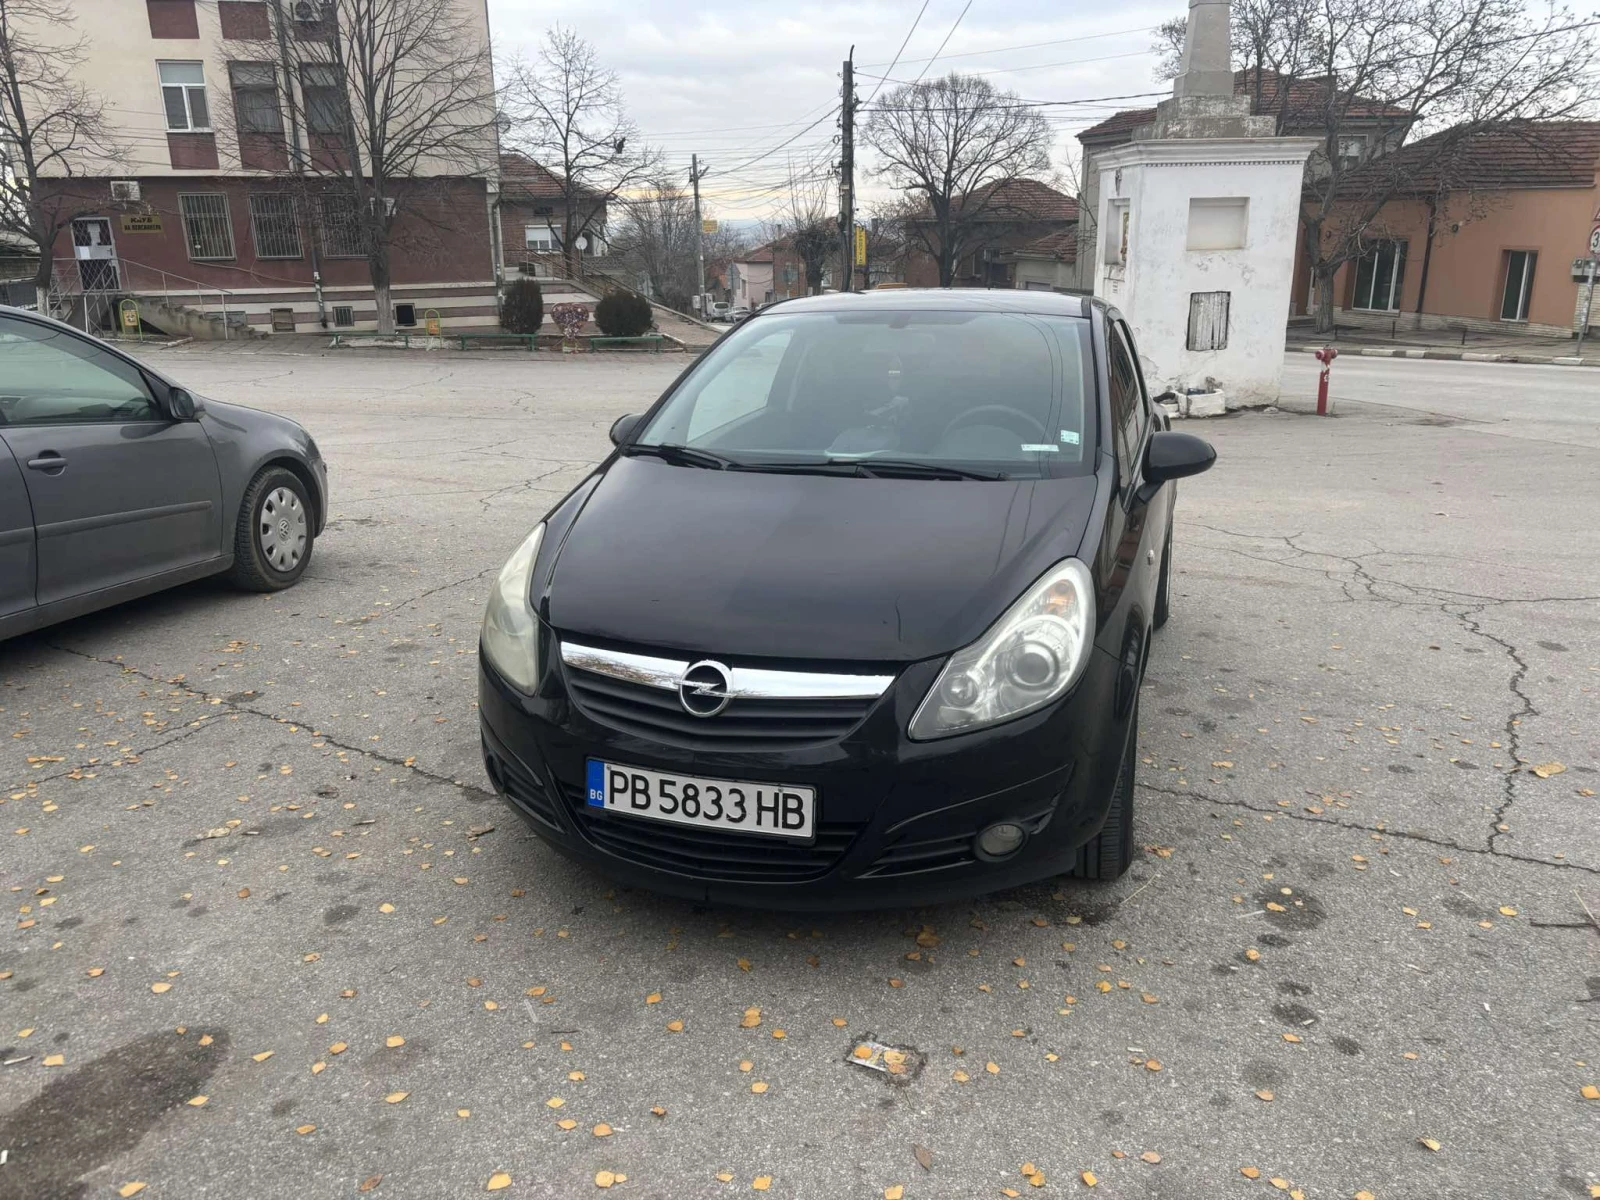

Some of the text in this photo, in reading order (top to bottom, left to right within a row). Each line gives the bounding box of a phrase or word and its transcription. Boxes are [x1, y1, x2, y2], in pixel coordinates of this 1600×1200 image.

[1592, 231, 1600, 248] 3
[589, 788, 604, 801] BG
[609, 769, 805, 830] PB 5833 HB
